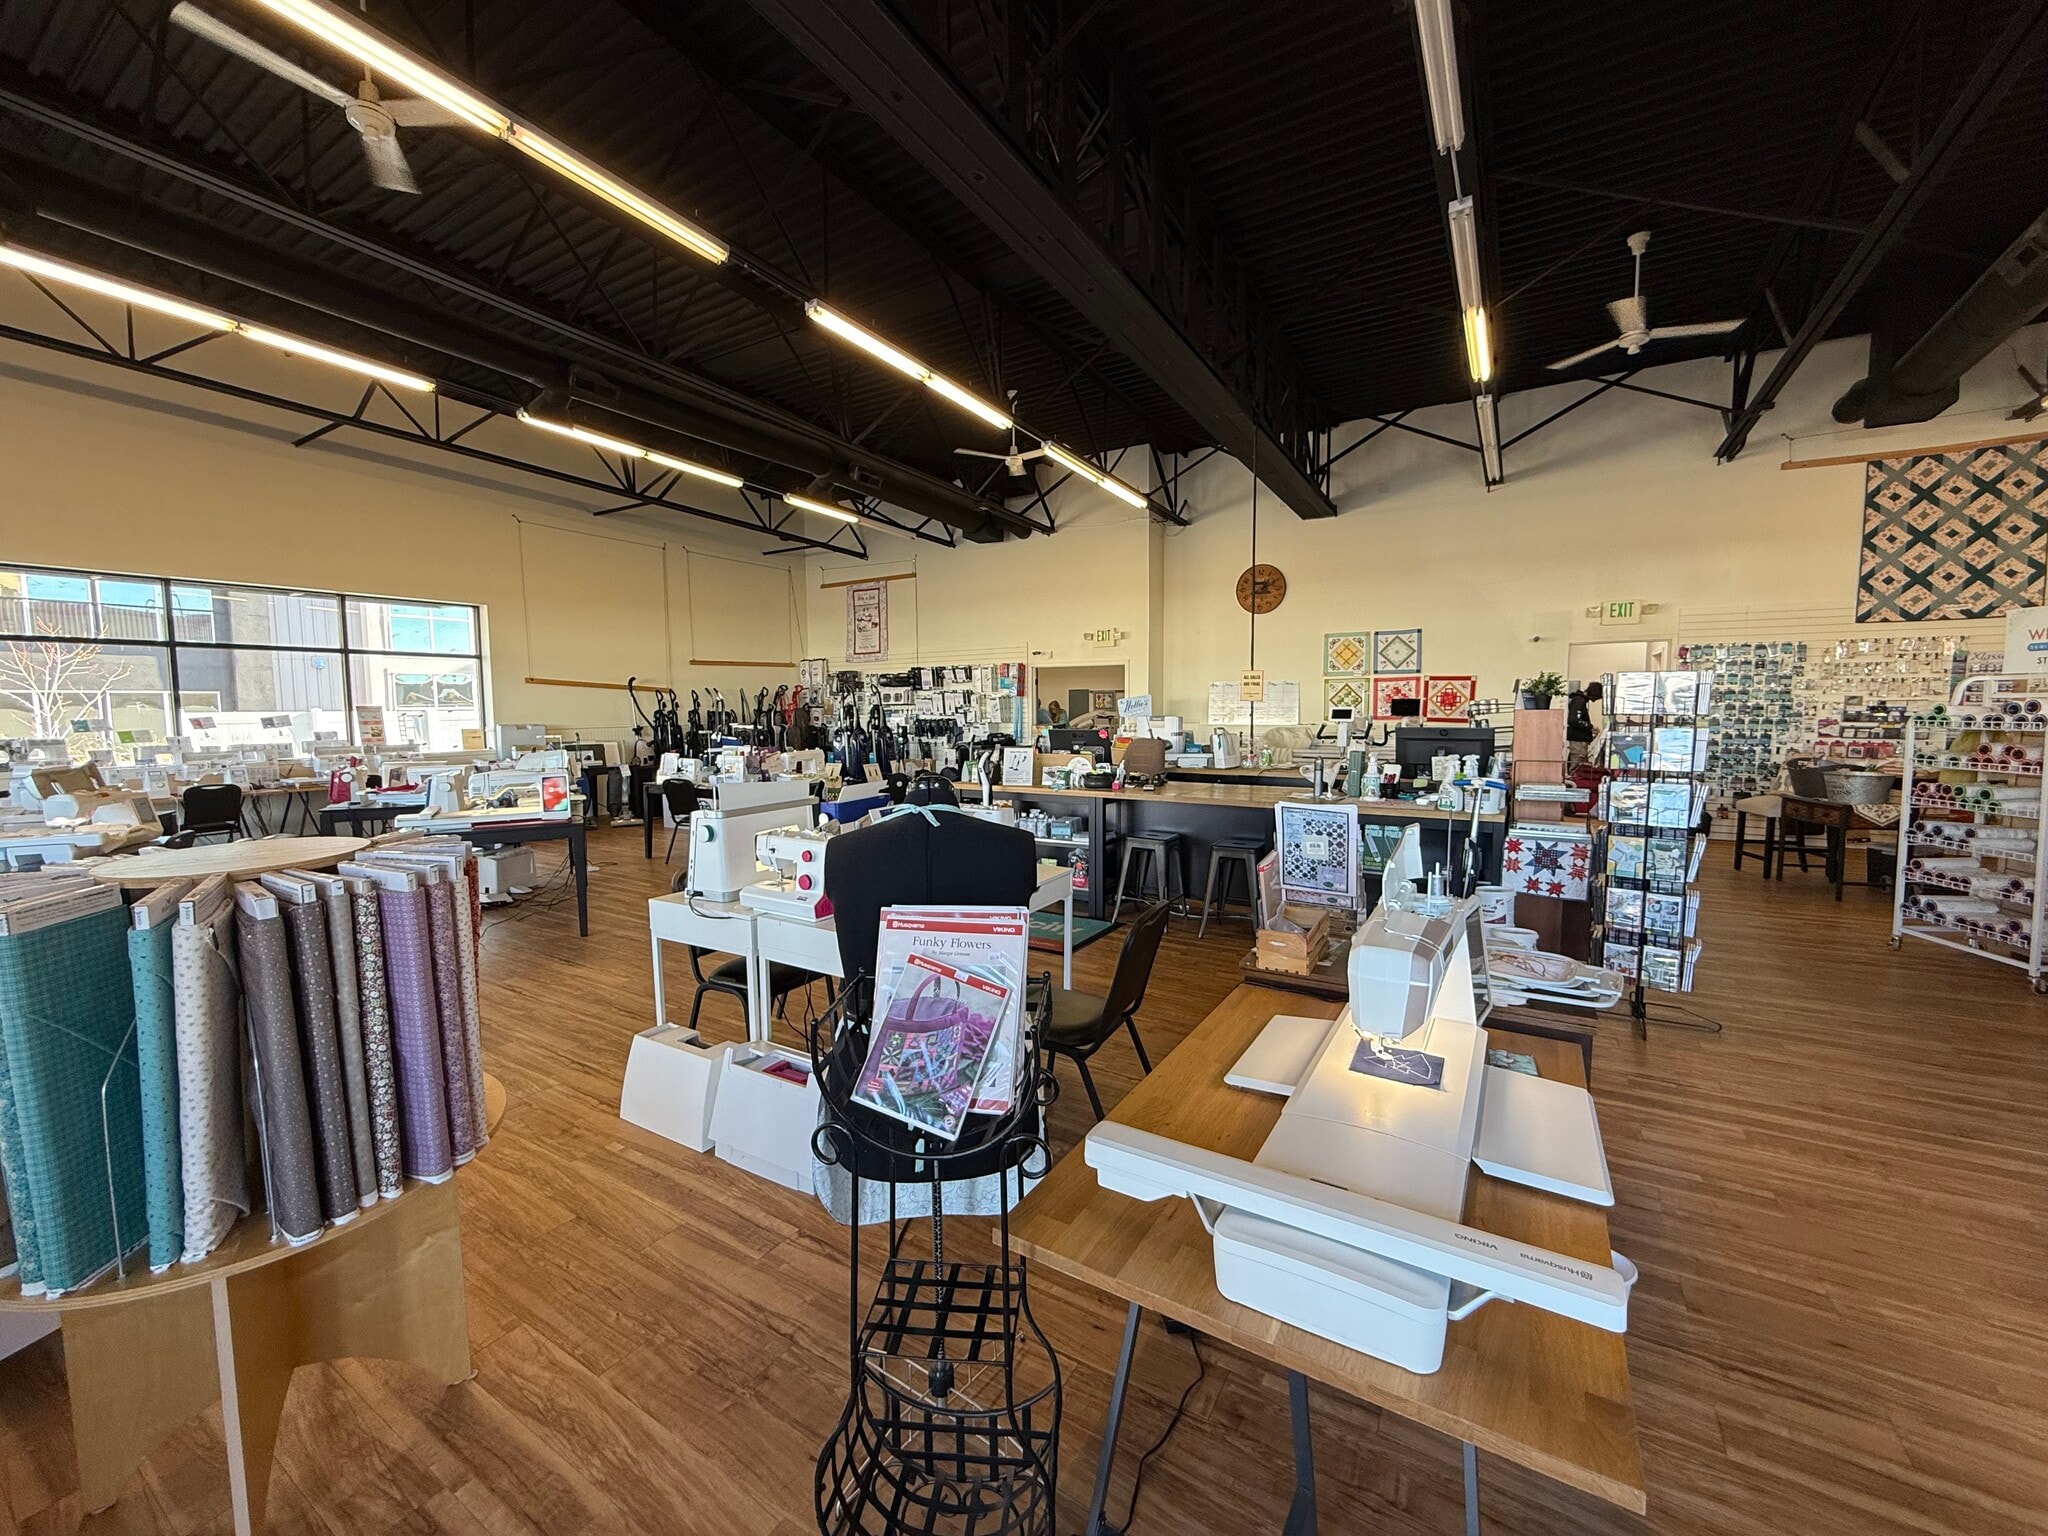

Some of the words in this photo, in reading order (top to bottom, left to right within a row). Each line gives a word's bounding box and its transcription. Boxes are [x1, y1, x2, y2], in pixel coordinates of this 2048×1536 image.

[1610, 601, 1635, 618] EXIT
[1096, 629, 1111, 642] EXIT
[912, 935, 947, 950] Funky
[950, 937, 992, 950] Flowers
[982, 984, 1002, 995] VIKING
[1454, 1232, 1499, 1251] VIKING
[1520, 1252, 1580, 1277] Husqvarna
